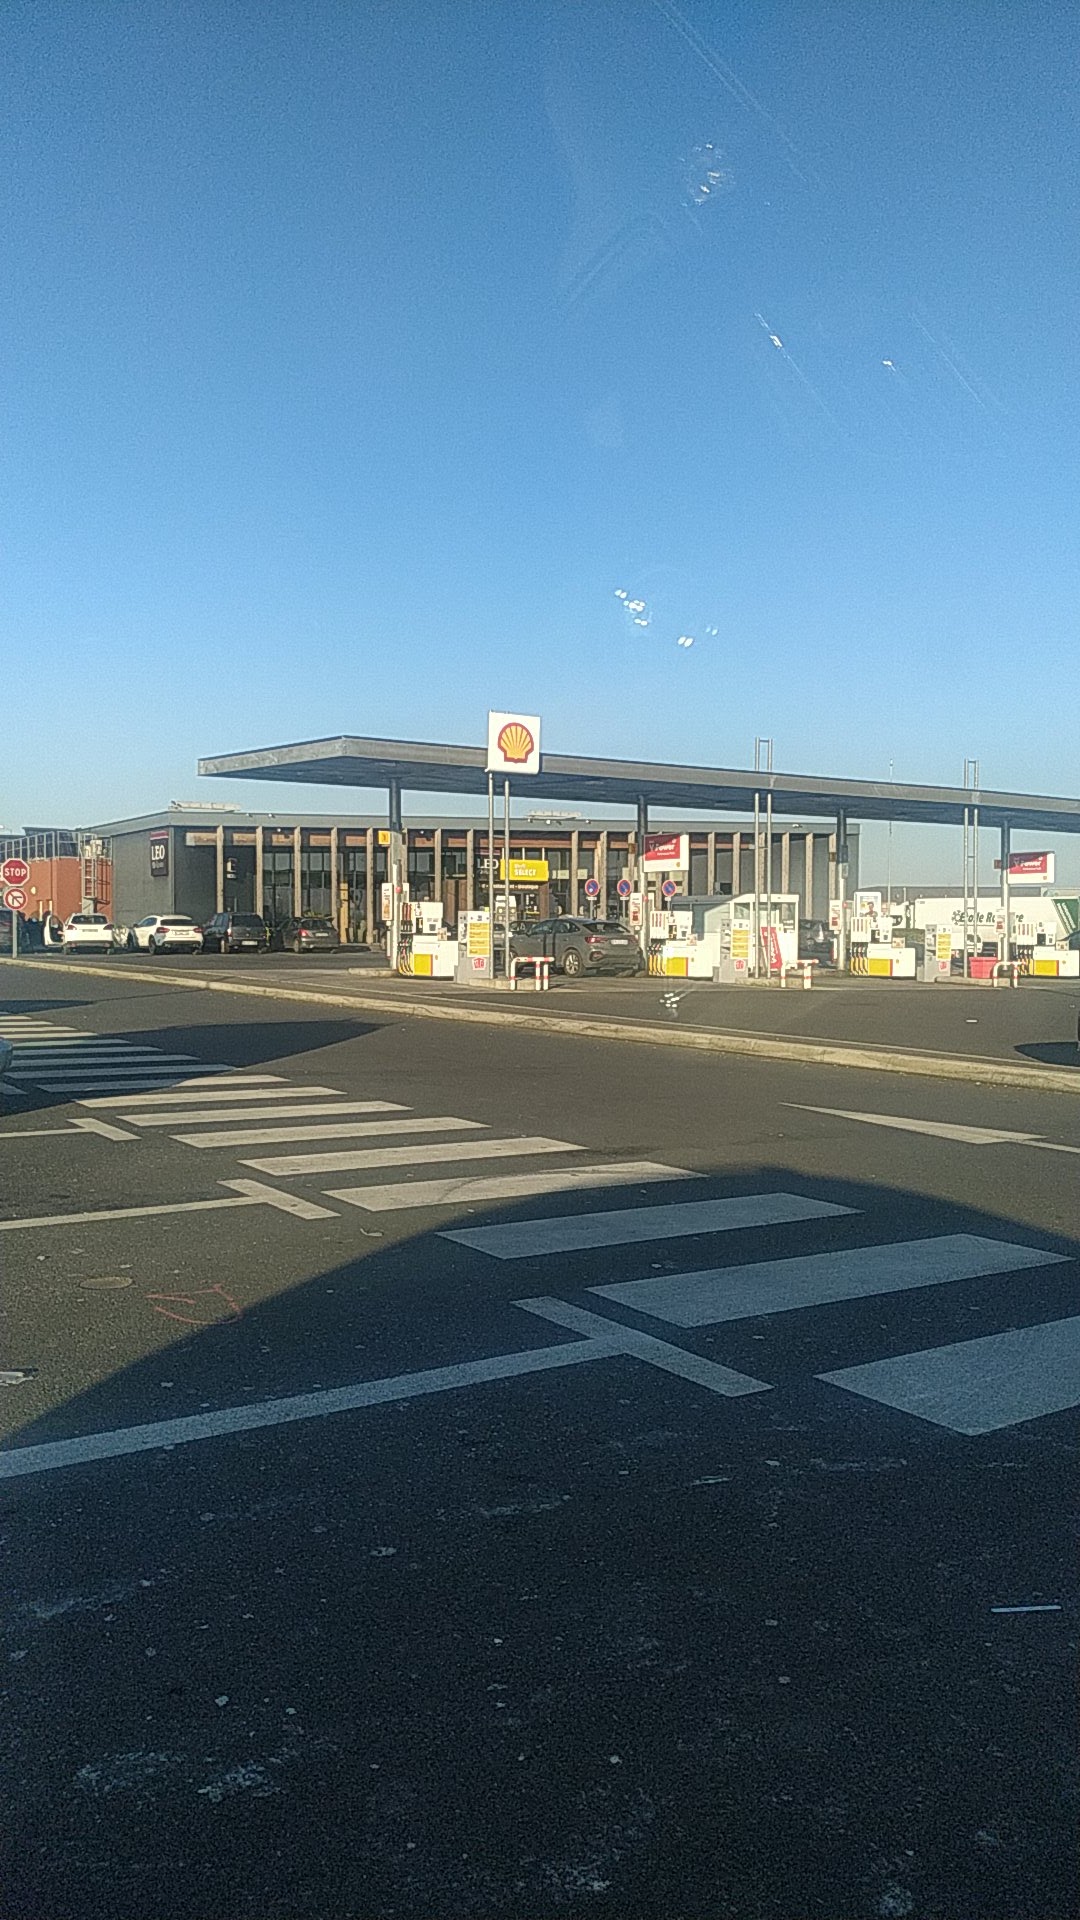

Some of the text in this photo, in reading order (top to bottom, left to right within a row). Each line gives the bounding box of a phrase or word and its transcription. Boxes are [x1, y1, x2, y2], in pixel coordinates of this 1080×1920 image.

[151, 843, 165, 860] LEO
[4, 868, 27, 877] STOP
[514, 868, 537, 876] SELECT
